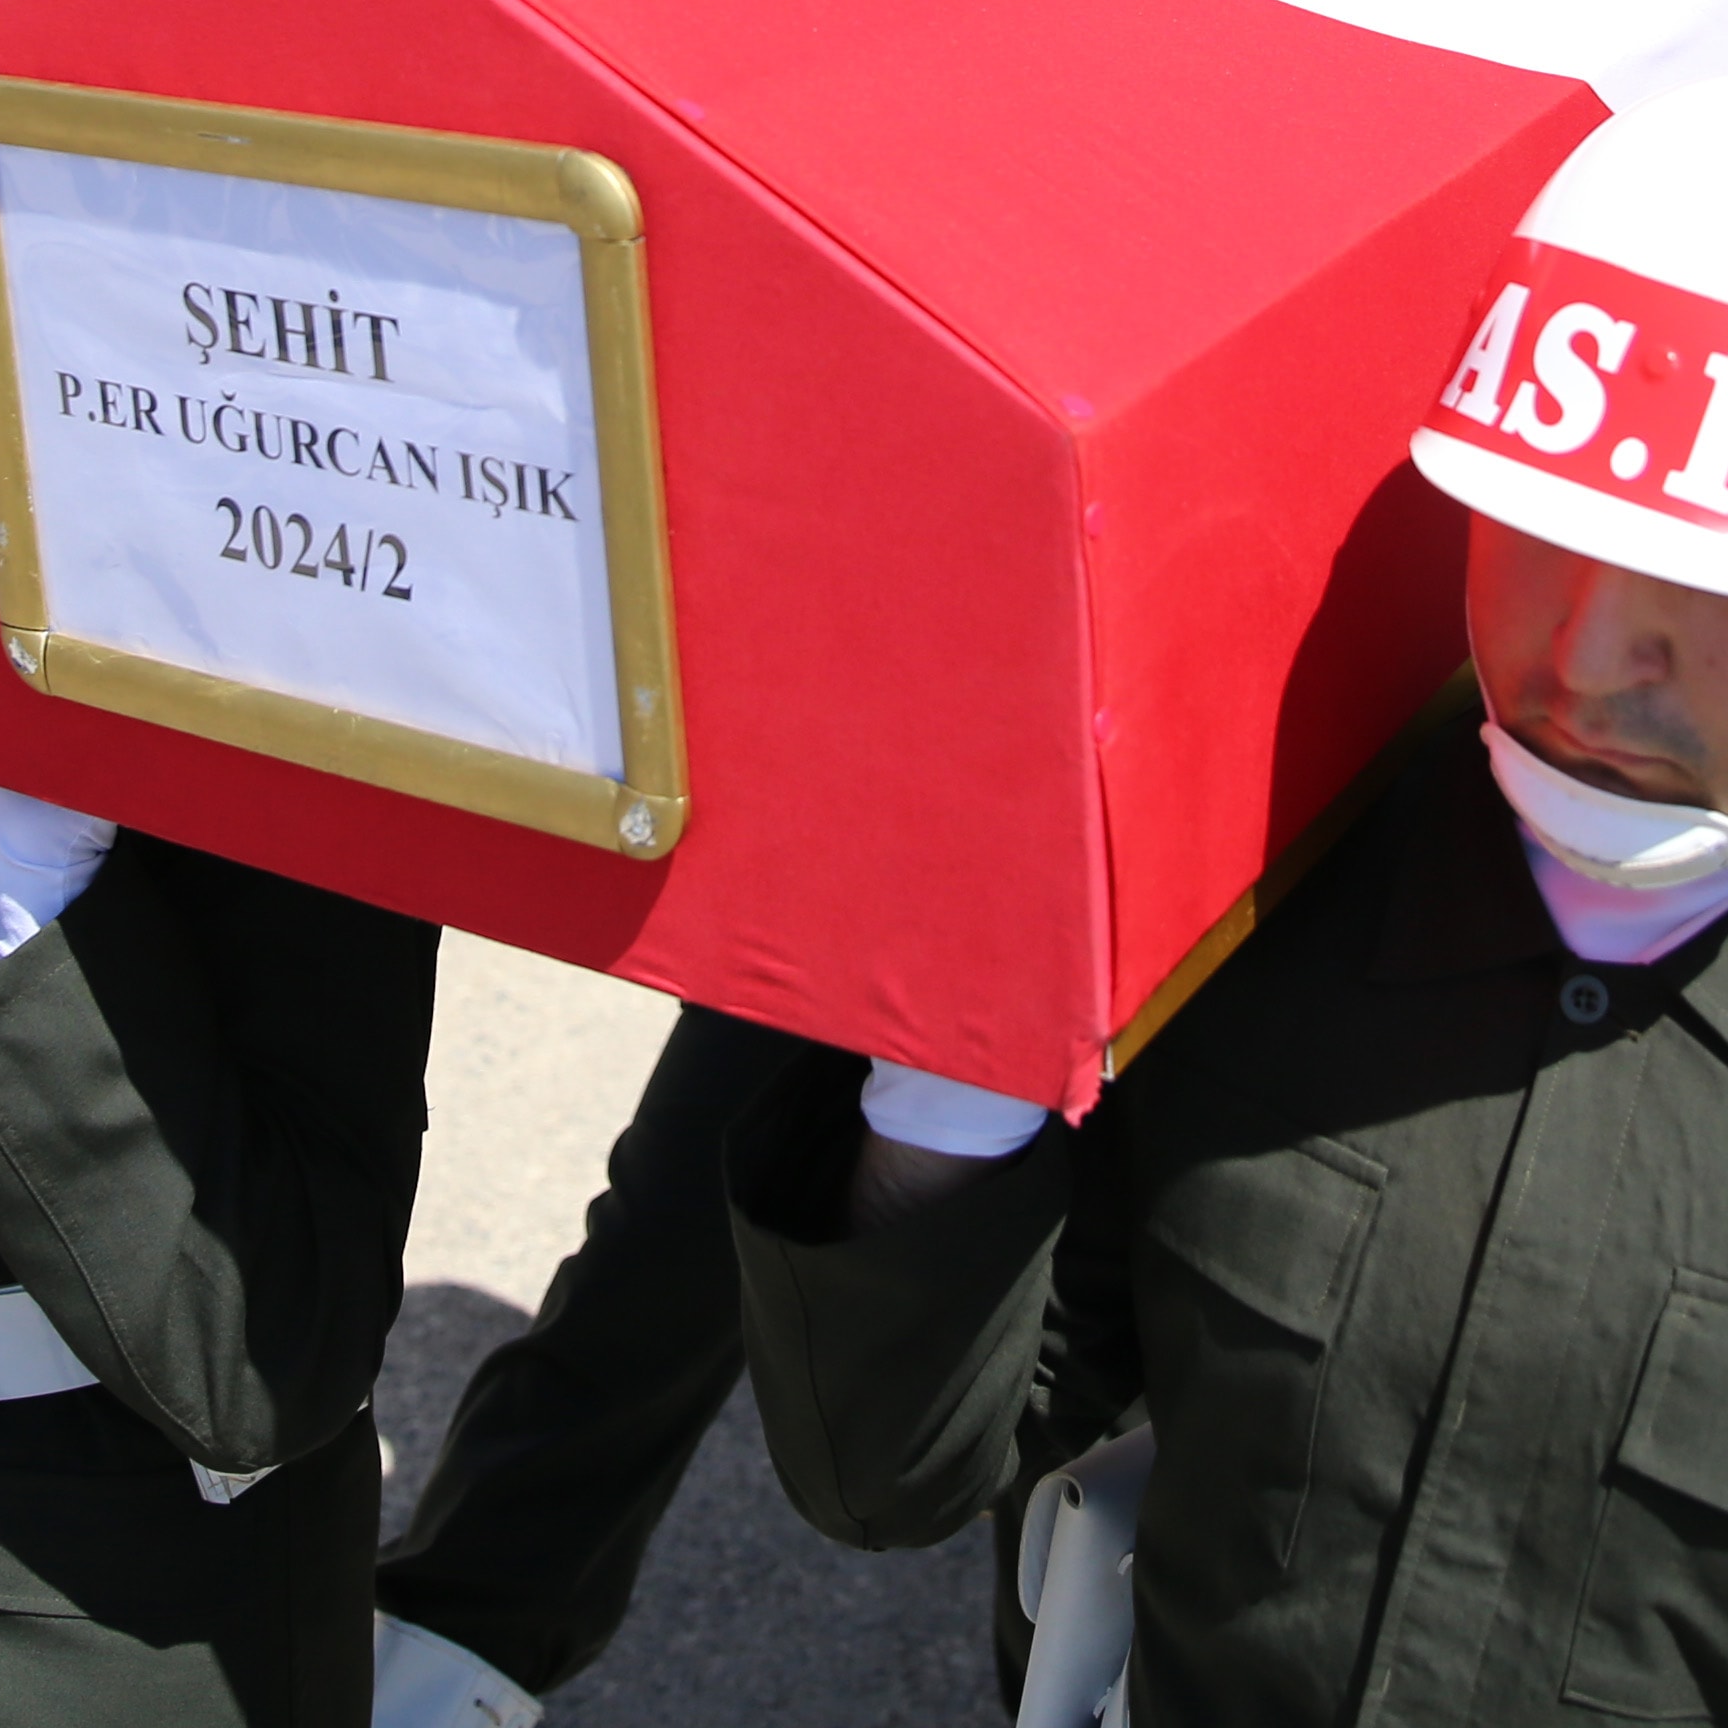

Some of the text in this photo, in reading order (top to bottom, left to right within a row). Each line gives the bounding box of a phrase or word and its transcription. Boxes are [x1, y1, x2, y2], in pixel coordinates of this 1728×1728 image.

[181, 281, 400, 383] ŞEHİT
[56, 370, 579, 524] P.ER UĞURCAN IŞIK
[214, 496, 416, 603] 2024/2
